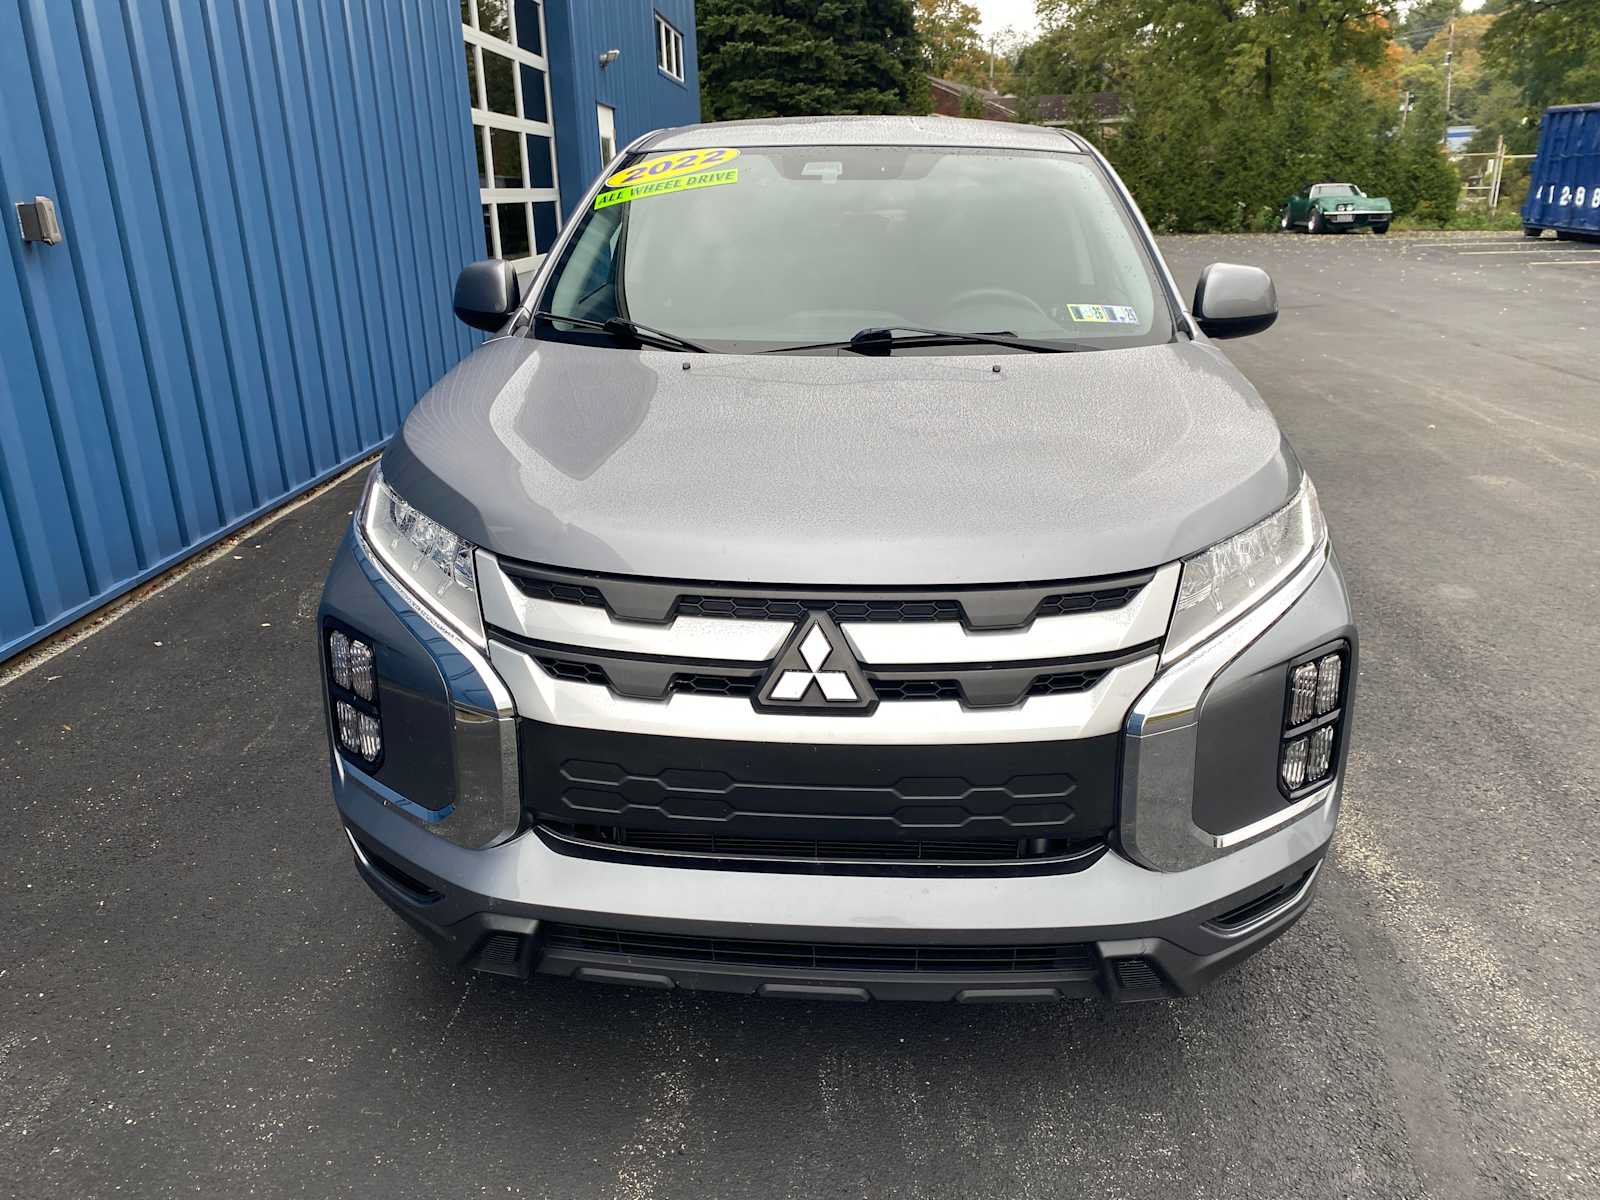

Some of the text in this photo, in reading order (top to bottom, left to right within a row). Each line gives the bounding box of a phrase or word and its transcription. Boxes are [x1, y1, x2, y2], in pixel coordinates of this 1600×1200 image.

[623, 149, 726, 183] 2022
[598, 170, 737, 204] ALL WHEEL DRIVE
